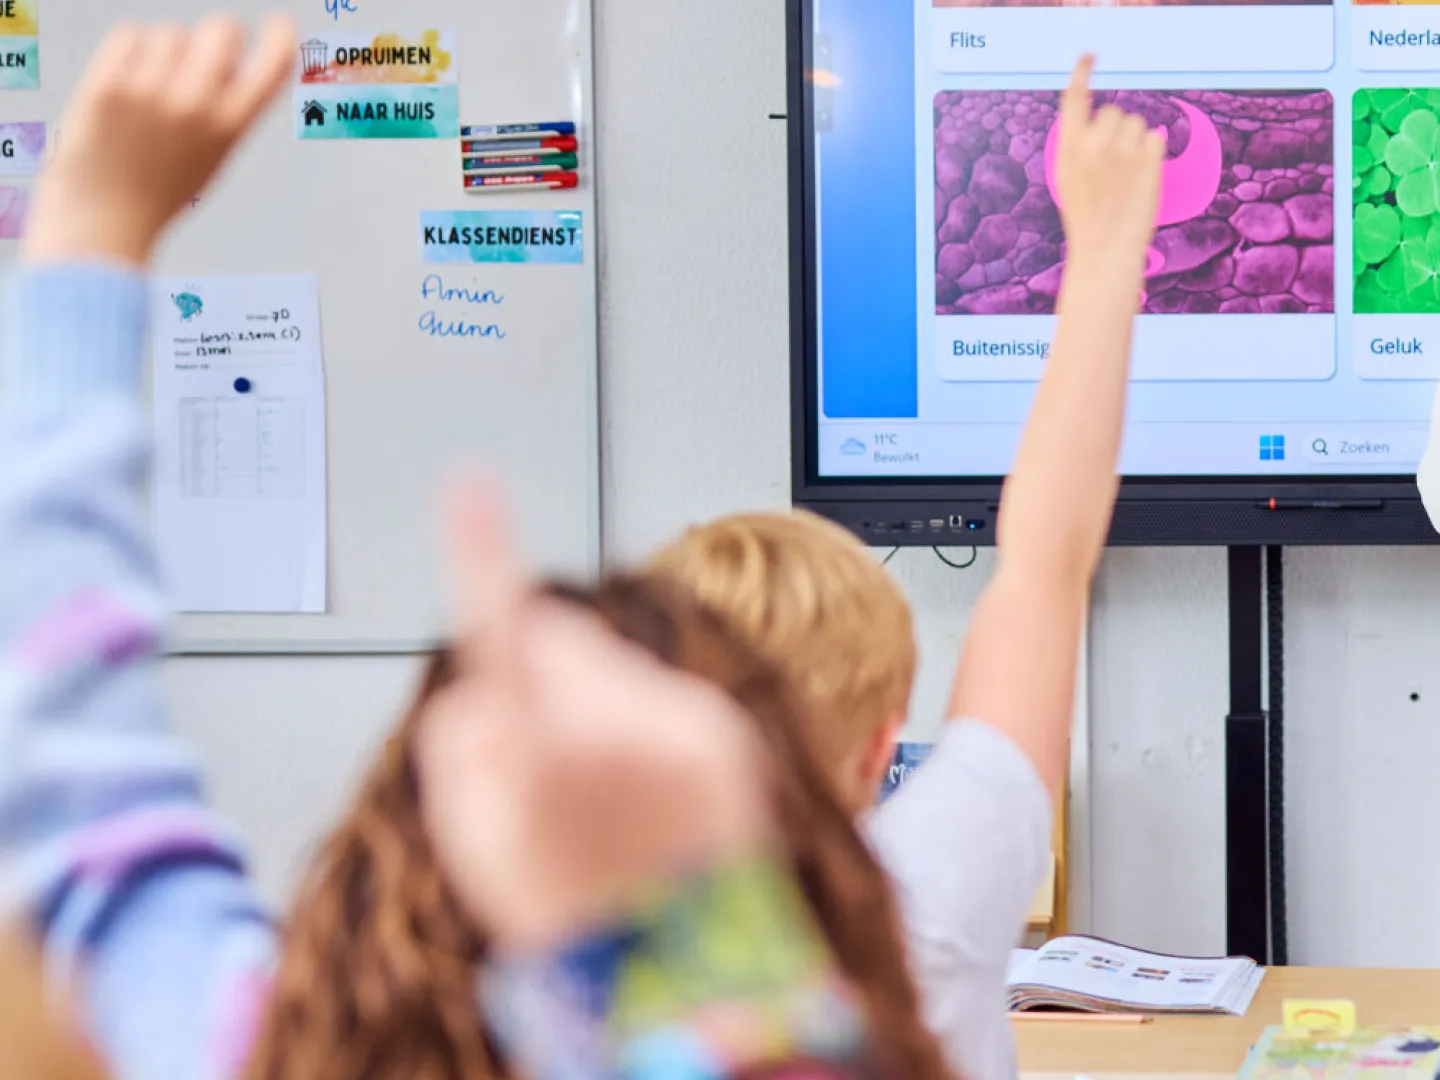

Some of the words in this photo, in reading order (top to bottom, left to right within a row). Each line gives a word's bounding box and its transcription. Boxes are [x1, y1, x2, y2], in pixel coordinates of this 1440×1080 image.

[950, 30, 986, 49] Flits
[335, 47, 431, 65] OPRUIMEN
[336, 103, 387, 120] NAAR
[394, 102, 435, 120] HUIS
[424, 226, 577, 246] KLASSENDIENST
[421, 274, 504, 304] Amin
[1370, 336, 1423, 355] Geluk
[1339, 440, 1390, 454] Zoeken
[873, 450, 920, 463] Bewolkt
